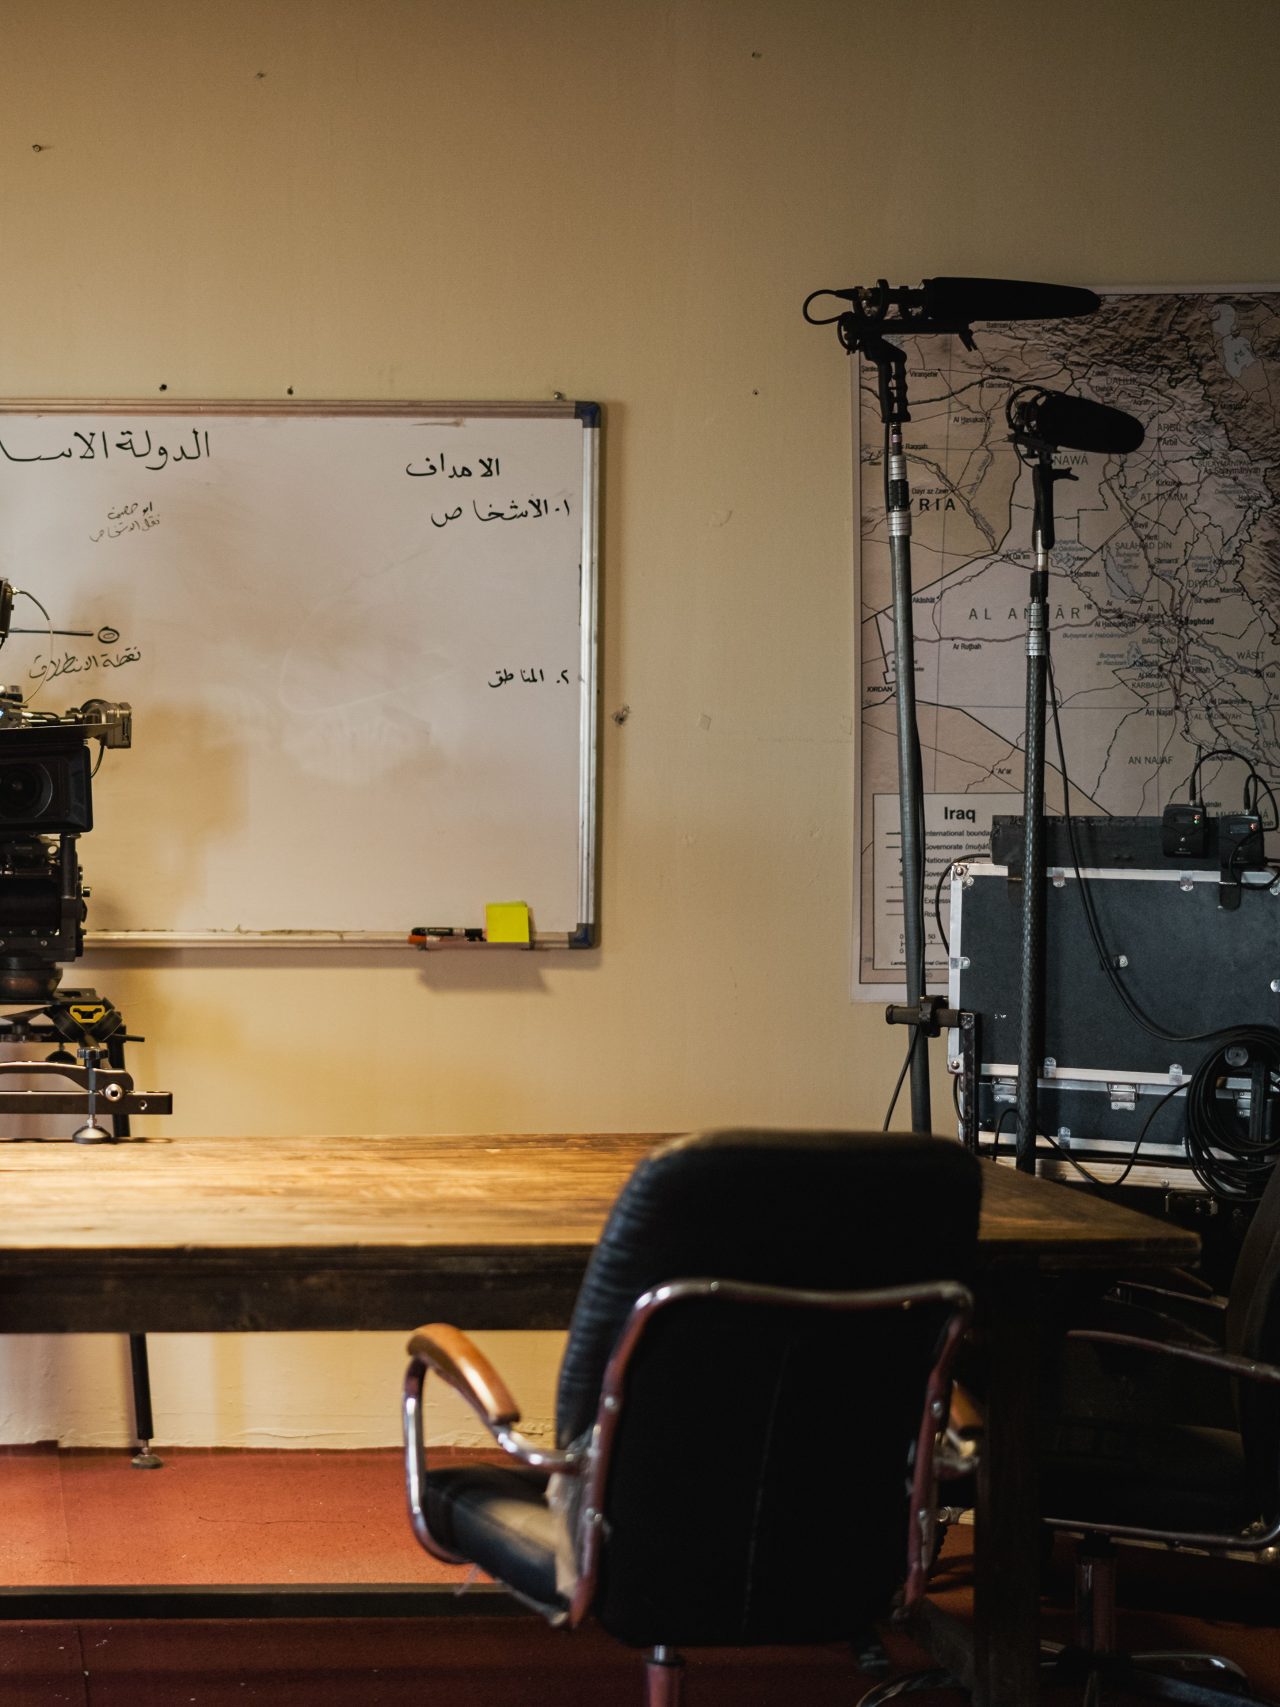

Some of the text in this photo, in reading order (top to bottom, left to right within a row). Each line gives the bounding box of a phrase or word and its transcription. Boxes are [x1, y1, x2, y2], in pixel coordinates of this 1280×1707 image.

[115, 427, 210, 470] الدولة
[406, 453, 500, 477] الاهداف
[968, 604, 1081, 620] AL ANĀR
[1128, 756, 1142, 765] AN
[943, 806, 977, 824] Iraq
